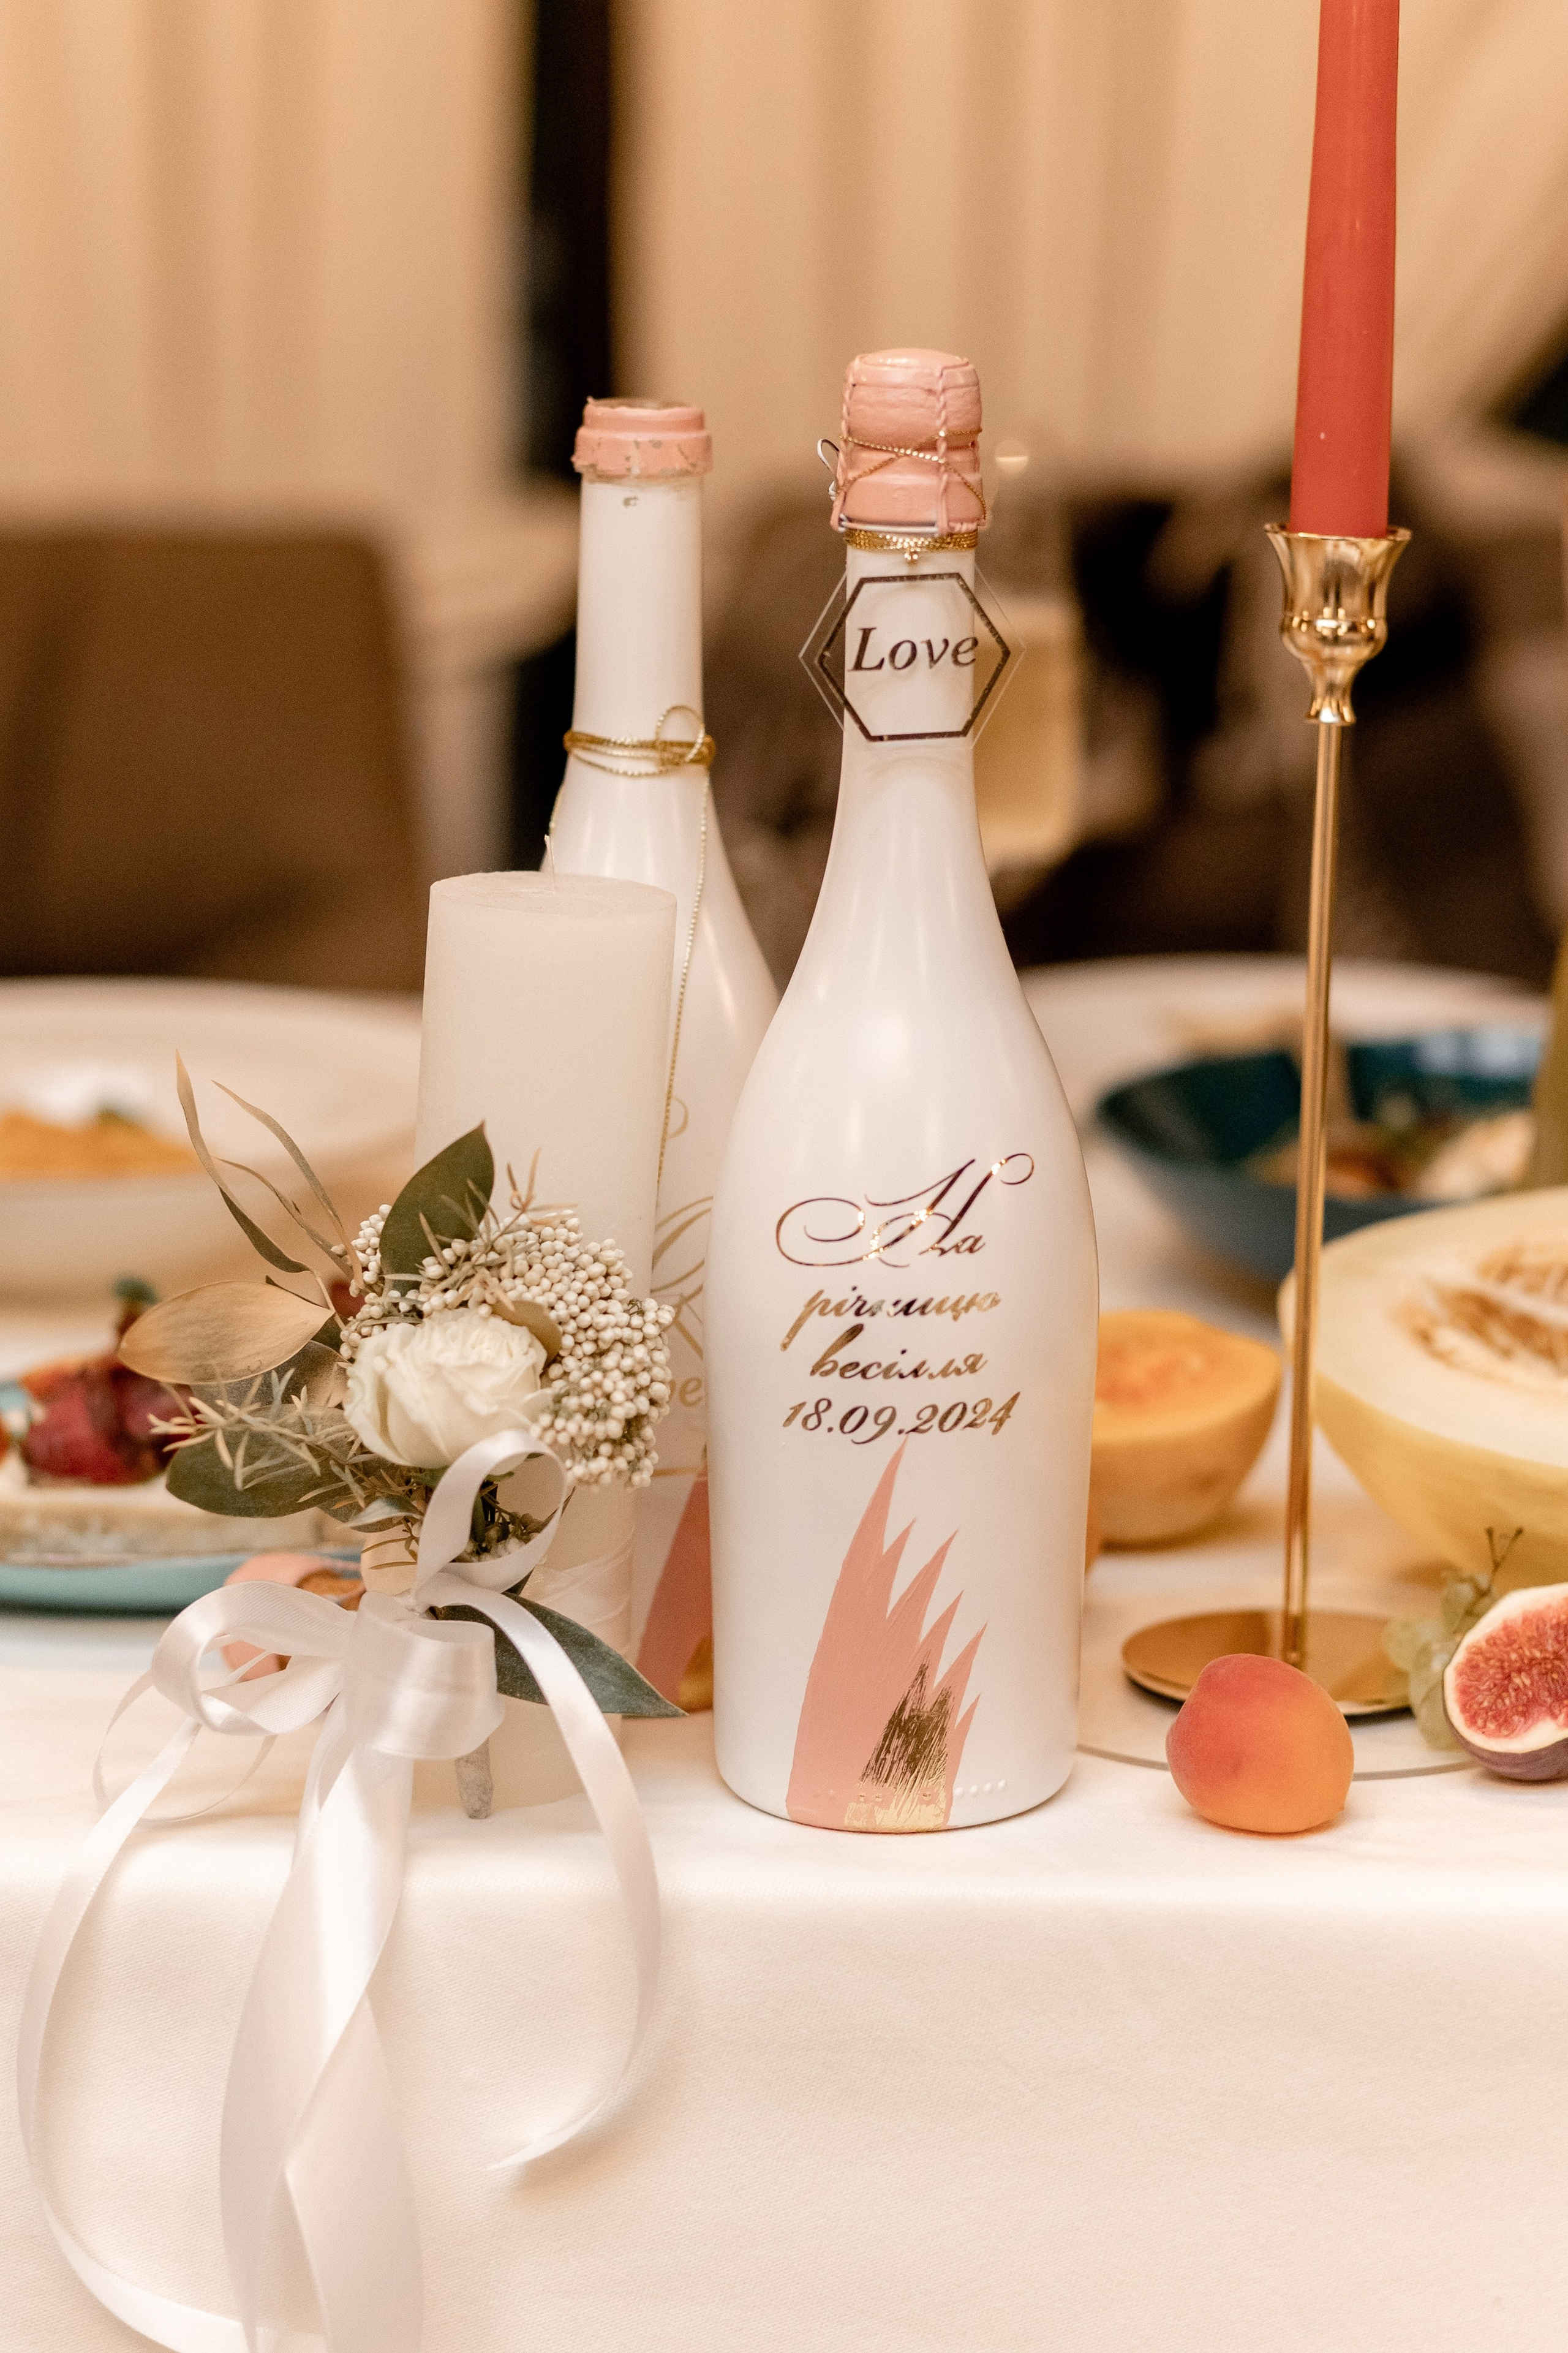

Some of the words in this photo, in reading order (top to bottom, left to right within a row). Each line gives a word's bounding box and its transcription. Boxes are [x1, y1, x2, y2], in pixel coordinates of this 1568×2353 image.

[848, 627, 979, 672] Love
[776, 1153, 1035, 1267] На
[810, 1323, 987, 1379] весілля
[782, 1391, 1021, 1445] 18.09.2024
